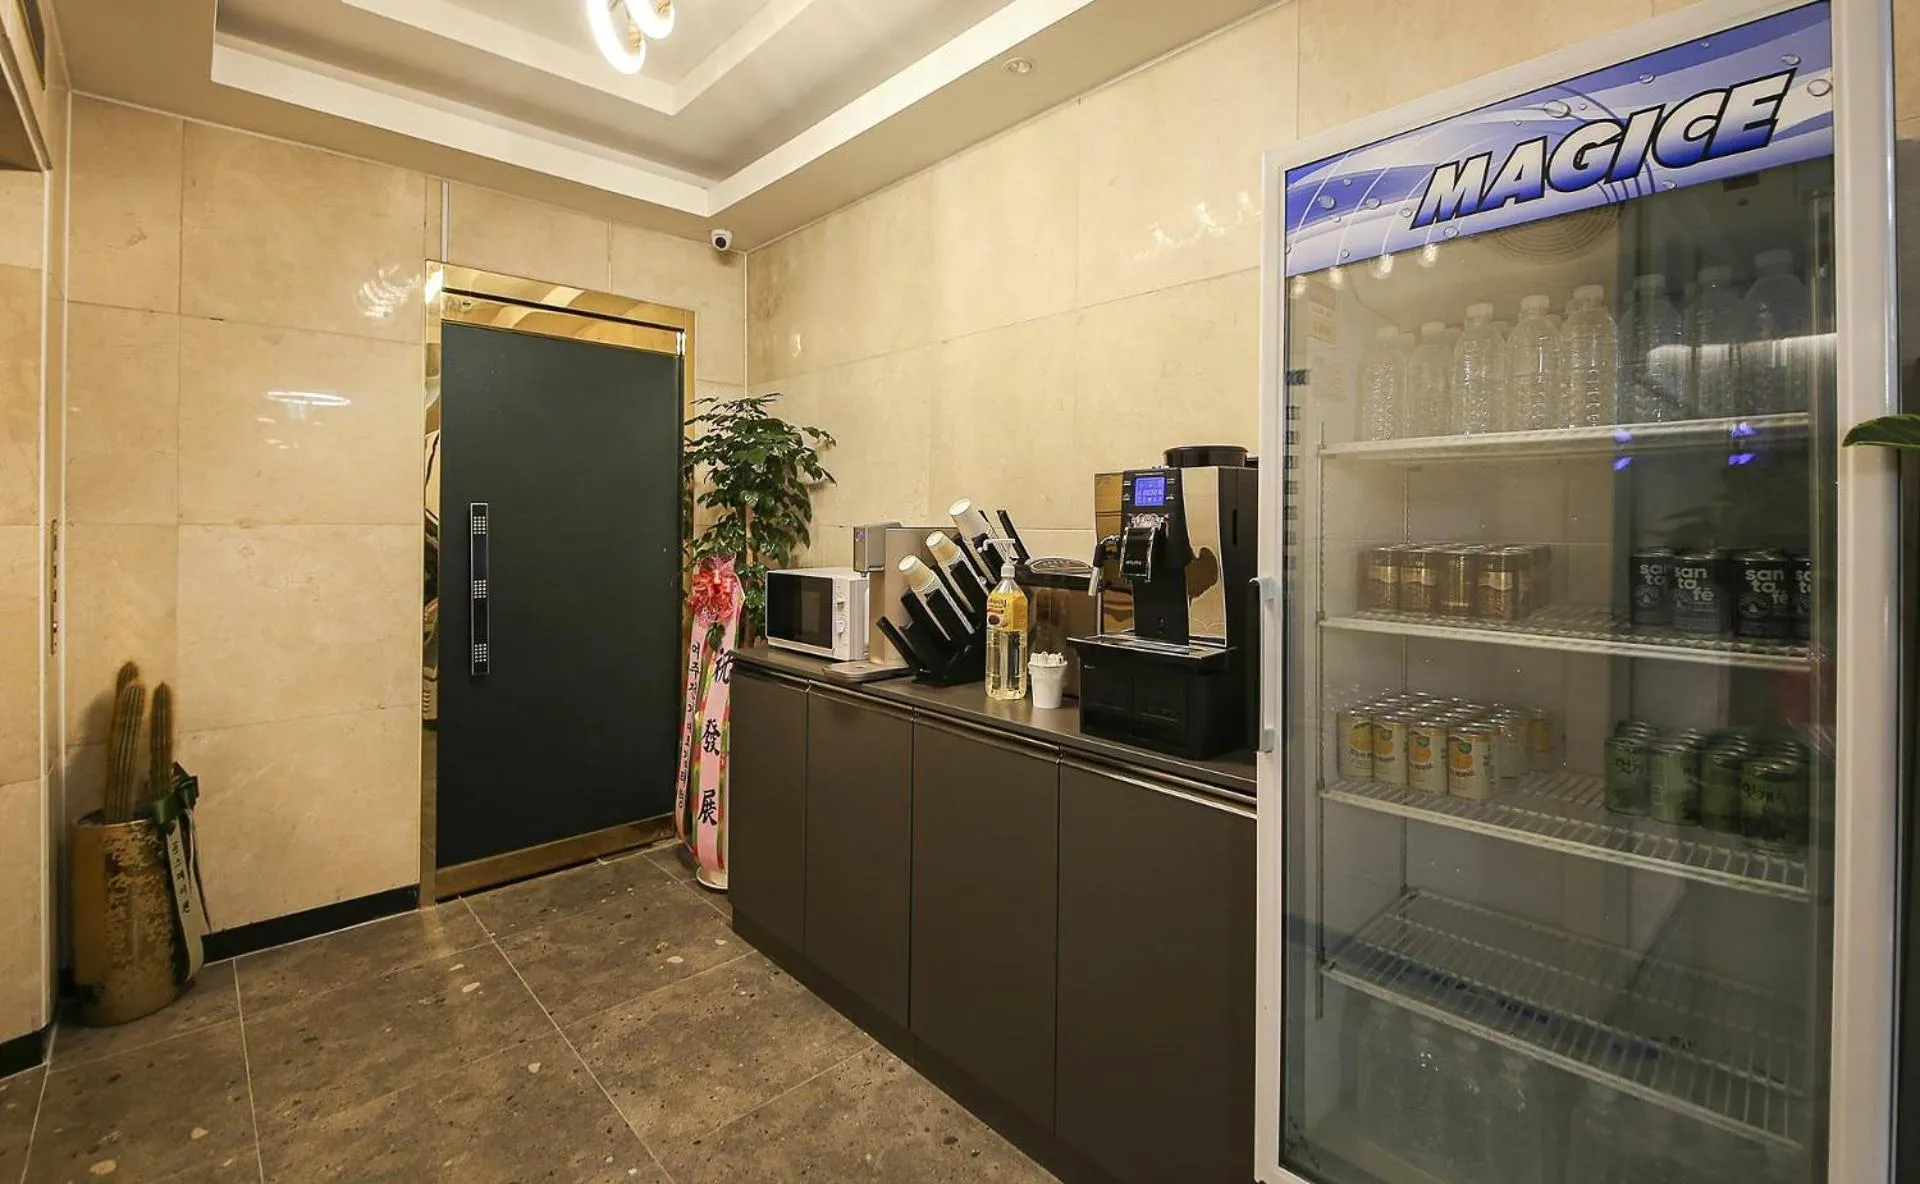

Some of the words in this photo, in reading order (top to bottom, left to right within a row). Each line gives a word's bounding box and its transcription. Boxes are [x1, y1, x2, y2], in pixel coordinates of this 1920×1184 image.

[1409, 67, 1797, 230] MAGICE
[1745, 569, 1785, 581] san
[1678, 578, 1698, 590] ta
[1750, 580, 1777, 593] ta
